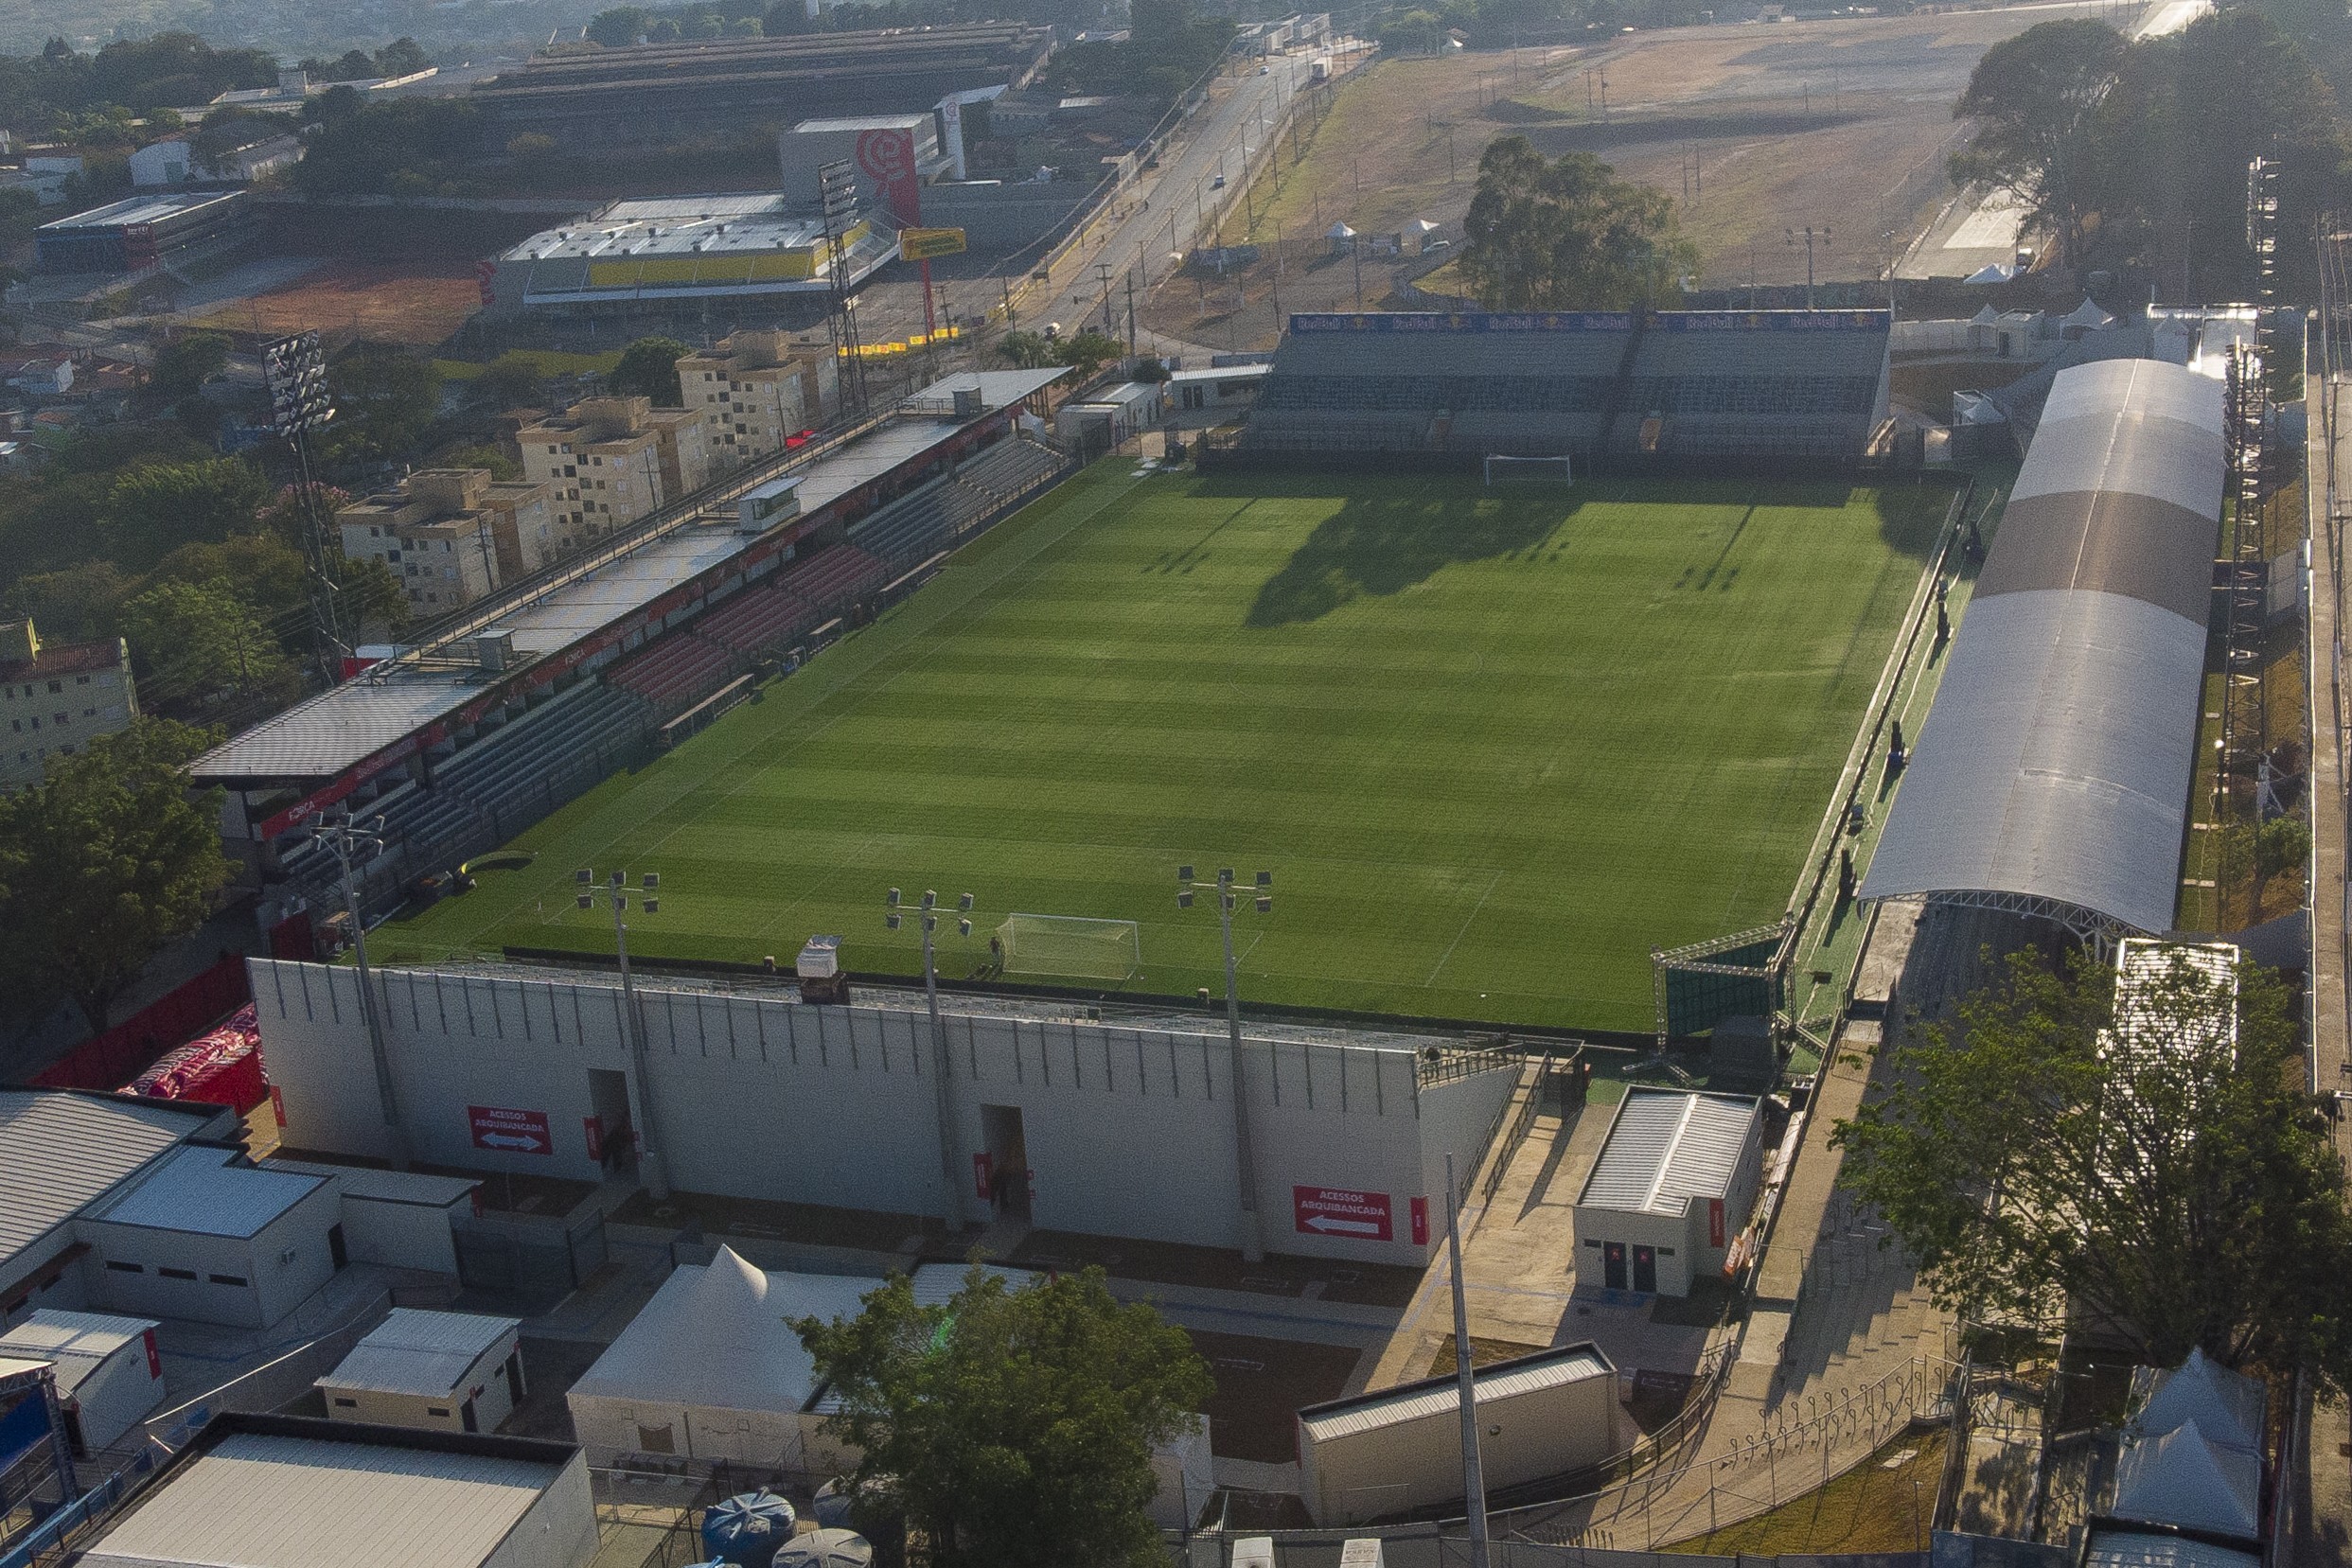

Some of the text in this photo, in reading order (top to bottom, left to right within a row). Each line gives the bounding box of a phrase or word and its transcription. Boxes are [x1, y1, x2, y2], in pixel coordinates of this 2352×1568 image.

[489, 1110, 527, 1121] ACESSOS
[475, 1120, 544, 1133] ARQUIBANCADA
[1319, 1190, 1365, 1203] ACESSOS
[1300, 1201, 1386, 1216] ARQUIBANCADA
